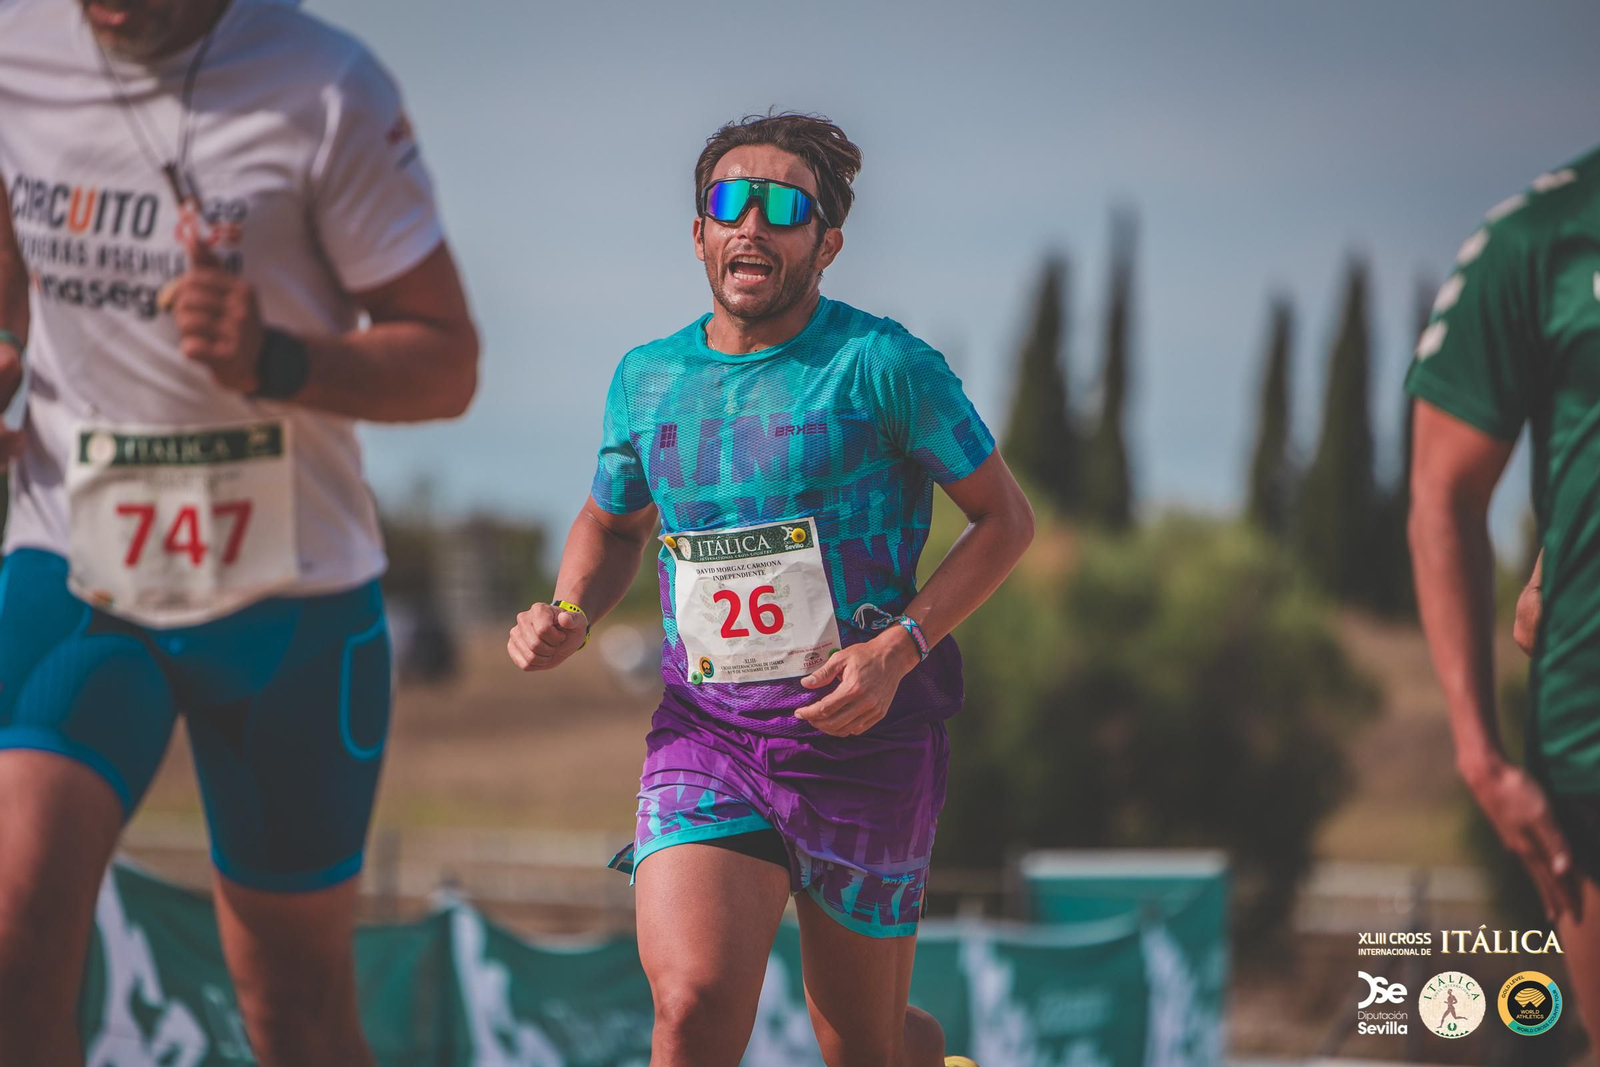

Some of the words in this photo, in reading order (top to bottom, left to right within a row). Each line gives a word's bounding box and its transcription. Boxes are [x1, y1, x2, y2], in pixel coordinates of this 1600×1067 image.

[11, 173, 159, 239] CIRCUITO
[115, 500, 255, 569] 747
[697, 534, 772, 557] ITÁLICA
[696, 567, 716, 575] DAVID
[716, 564, 746, 574] MORGAZ
[746, 560, 782, 570] CARMONA
[712, 569, 767, 581] INDEPENDIENTE
[713, 585, 785, 639] 26
